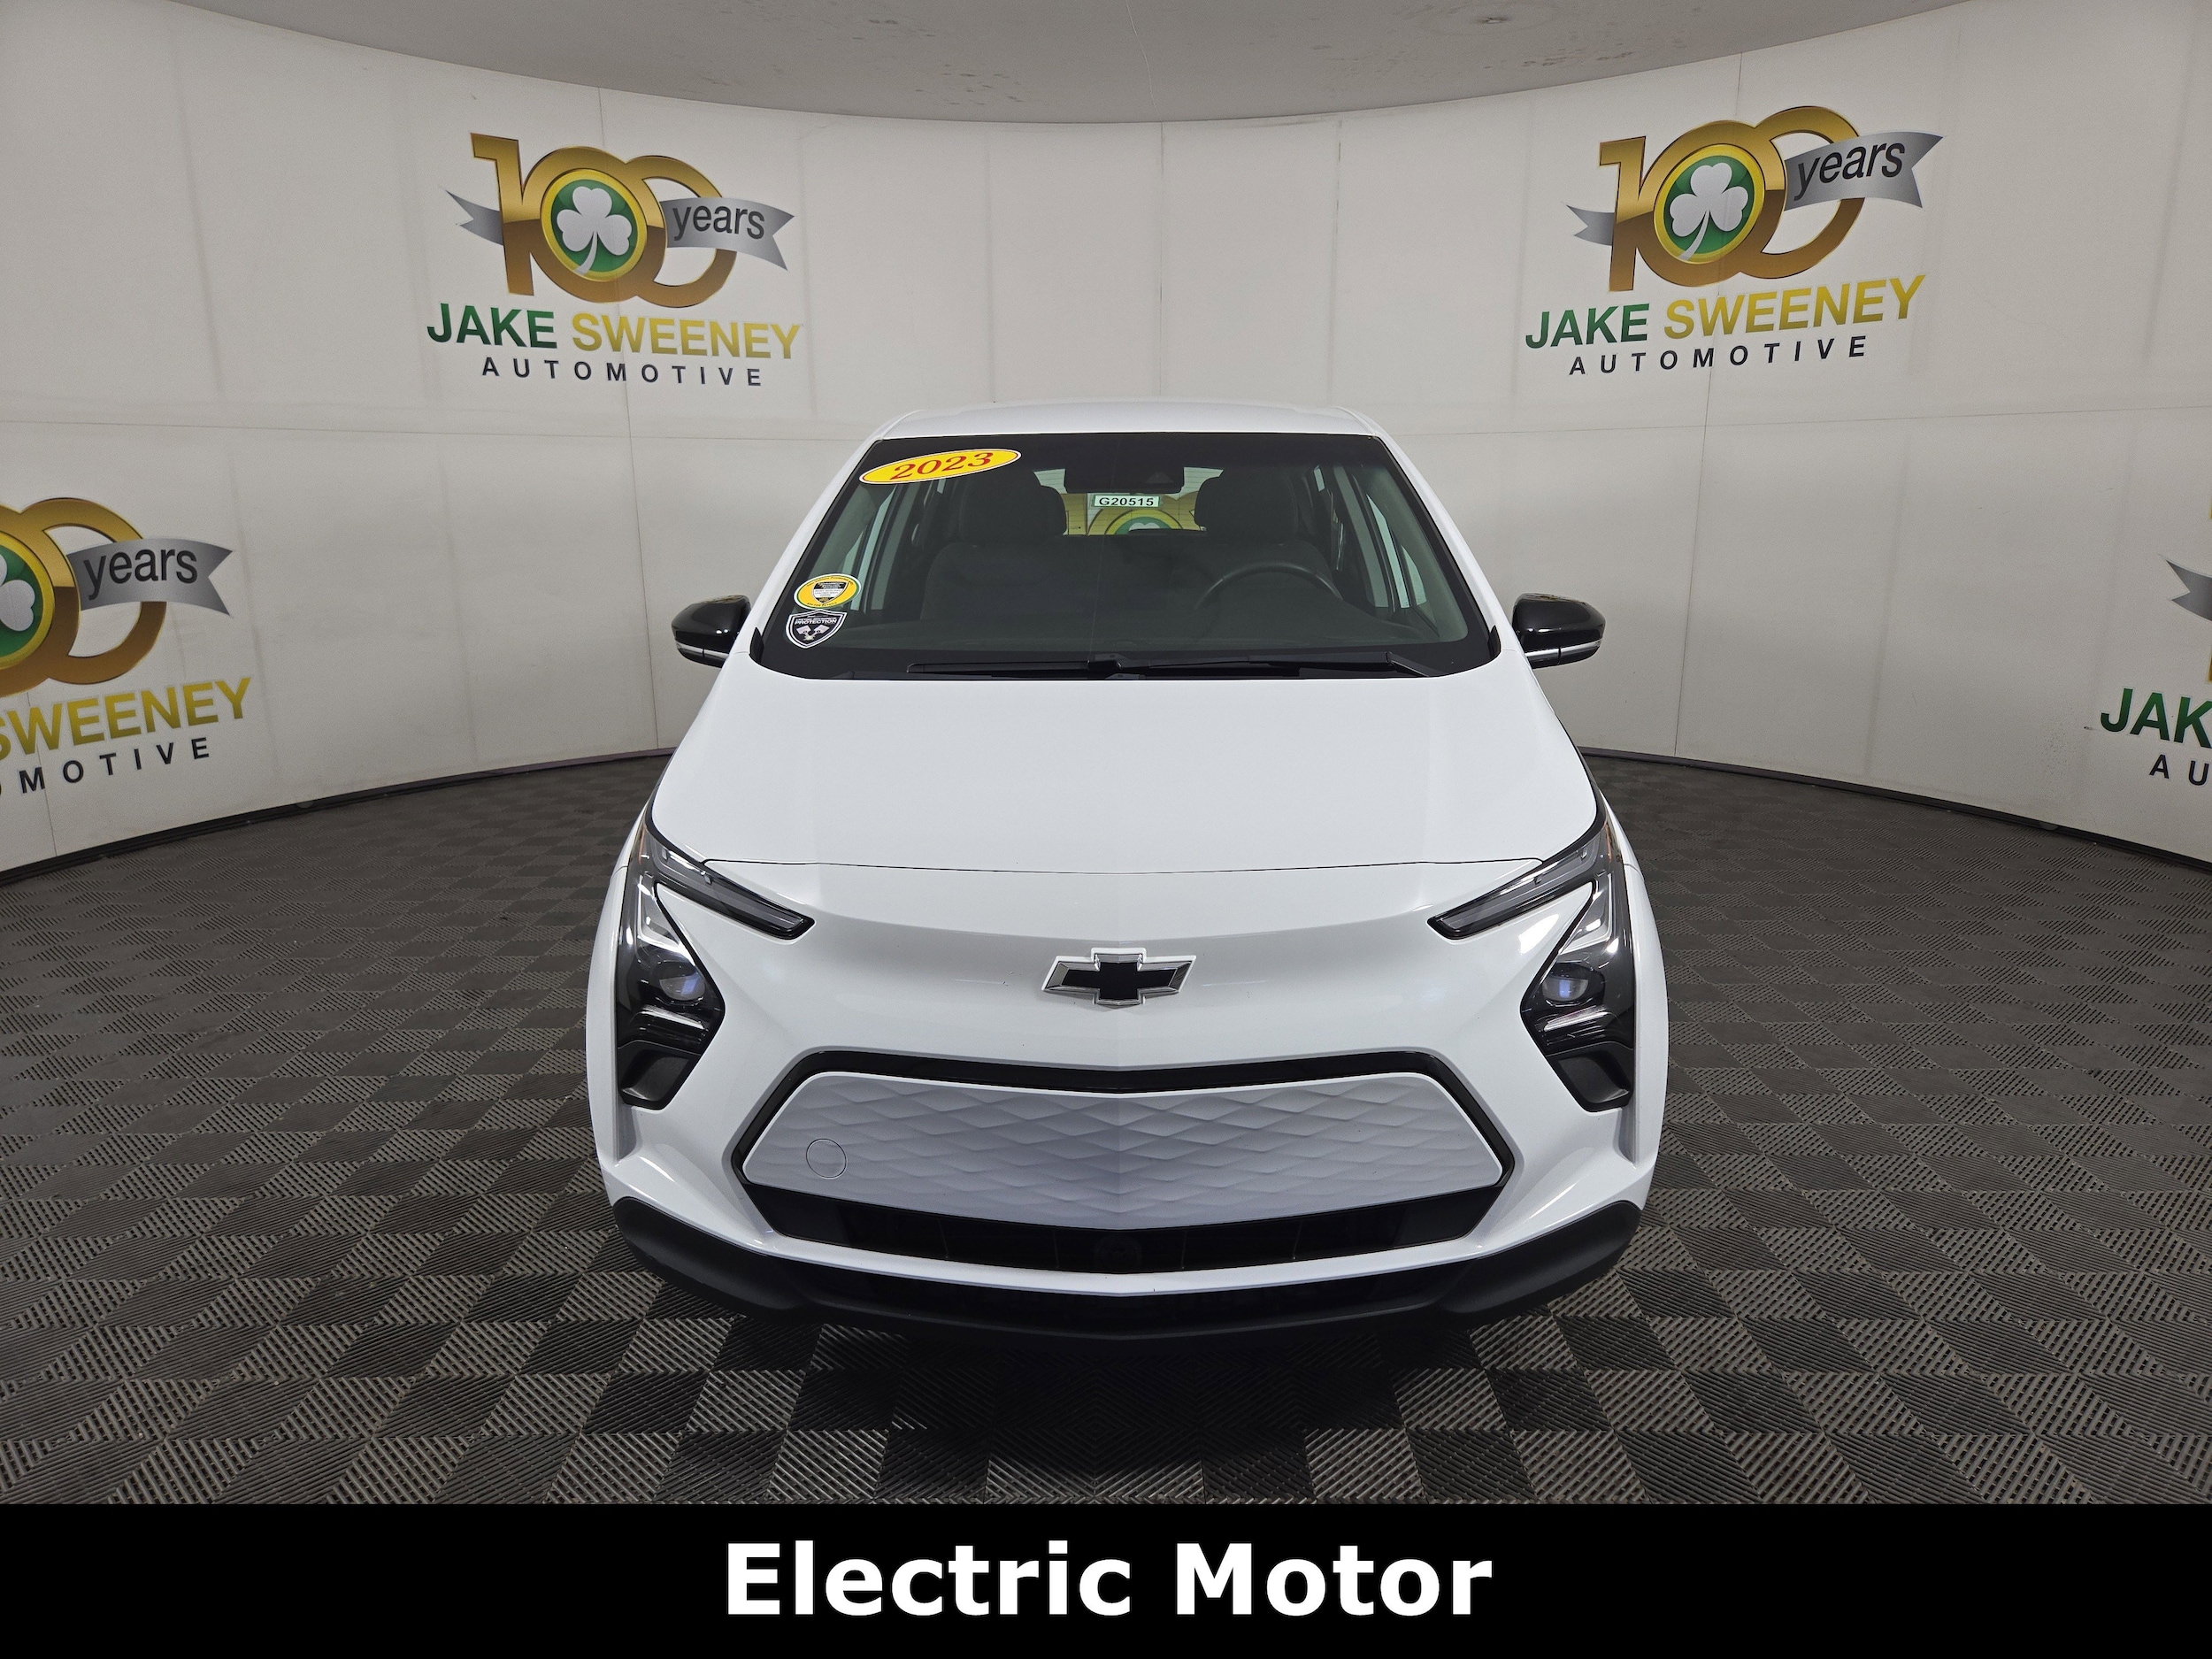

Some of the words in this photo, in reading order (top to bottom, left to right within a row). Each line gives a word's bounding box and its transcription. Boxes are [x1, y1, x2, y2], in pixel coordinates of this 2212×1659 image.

[1793, 142, 1906, 202] years
[672, 204, 766, 242] years
[426, 303, 558, 349] JAKE
[572, 312, 801, 359] SWEENEY
[1525, 303, 1650, 349] JAKE
[1664, 274, 1926, 340] SWEENEY
[481, 357, 762, 386] AUTOMOTIVE
[1569, 335, 1867, 376] AUTOMOTIVE
[889, 452, 994, 480] 2023
[1099, 497, 1155, 506] G20515
[83, 549, 198, 601] years
